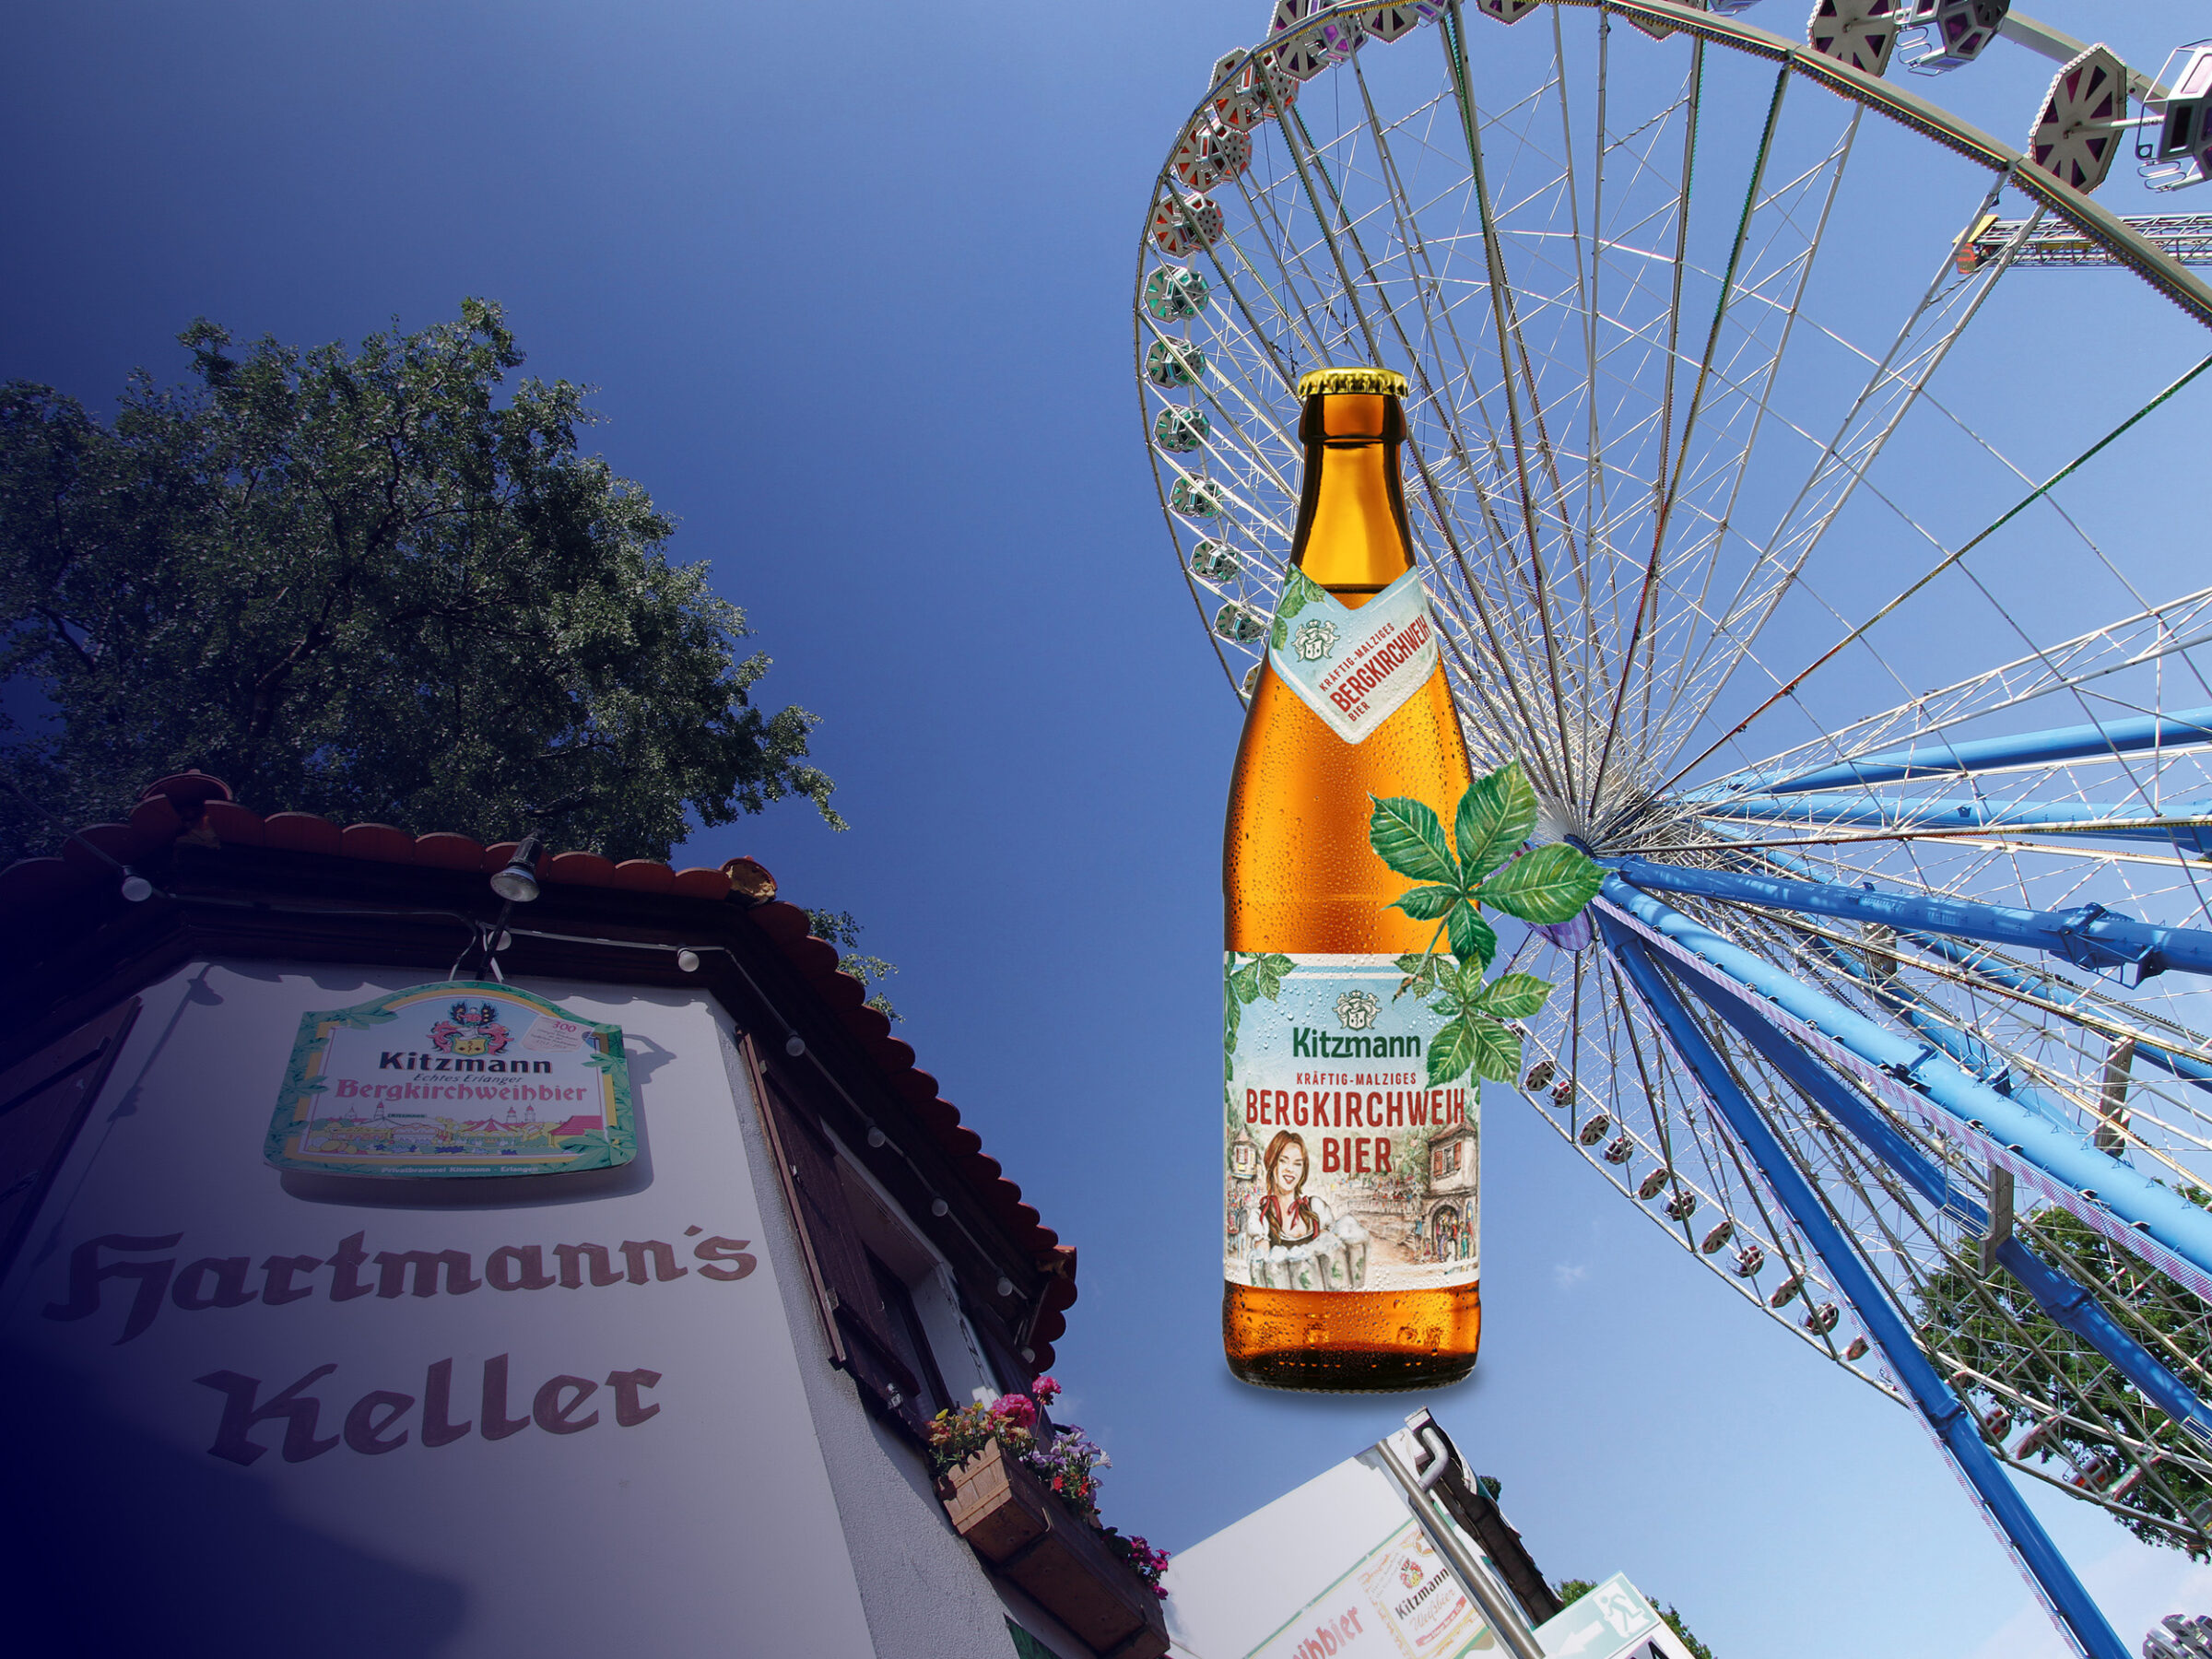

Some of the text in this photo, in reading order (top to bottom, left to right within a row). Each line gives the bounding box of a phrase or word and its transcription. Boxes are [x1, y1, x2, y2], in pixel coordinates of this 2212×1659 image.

[1319, 622, 1395, 692] KRÄFTIG-MALZIGES
[1329, 614, 1432, 713] BERGKIRCHWEIH
[1348, 701, 1371, 723] BIER
[552, 1020, 577, 1033] 300
[1292, 1027, 1421, 1059] Kitzmann
[378, 1051, 553, 1075] Kitzmann
[335, 1078, 588, 1101] Bergkirchweihbier
[414, 1073, 523, 1086] Echtes Erlanger
[1296, 1071, 1417, 1086] KRÄFTIG-MALZIGES
[1246, 1088, 1465, 1128] BERGKIRCHWEIH
[500, 1165, 539, 1173] Erlangen
[1322, 1137, 1393, 1173] BIER
[193, 1353, 663, 1466] Keller
[1394, 1568, 1450, 1620] Kitzmann
